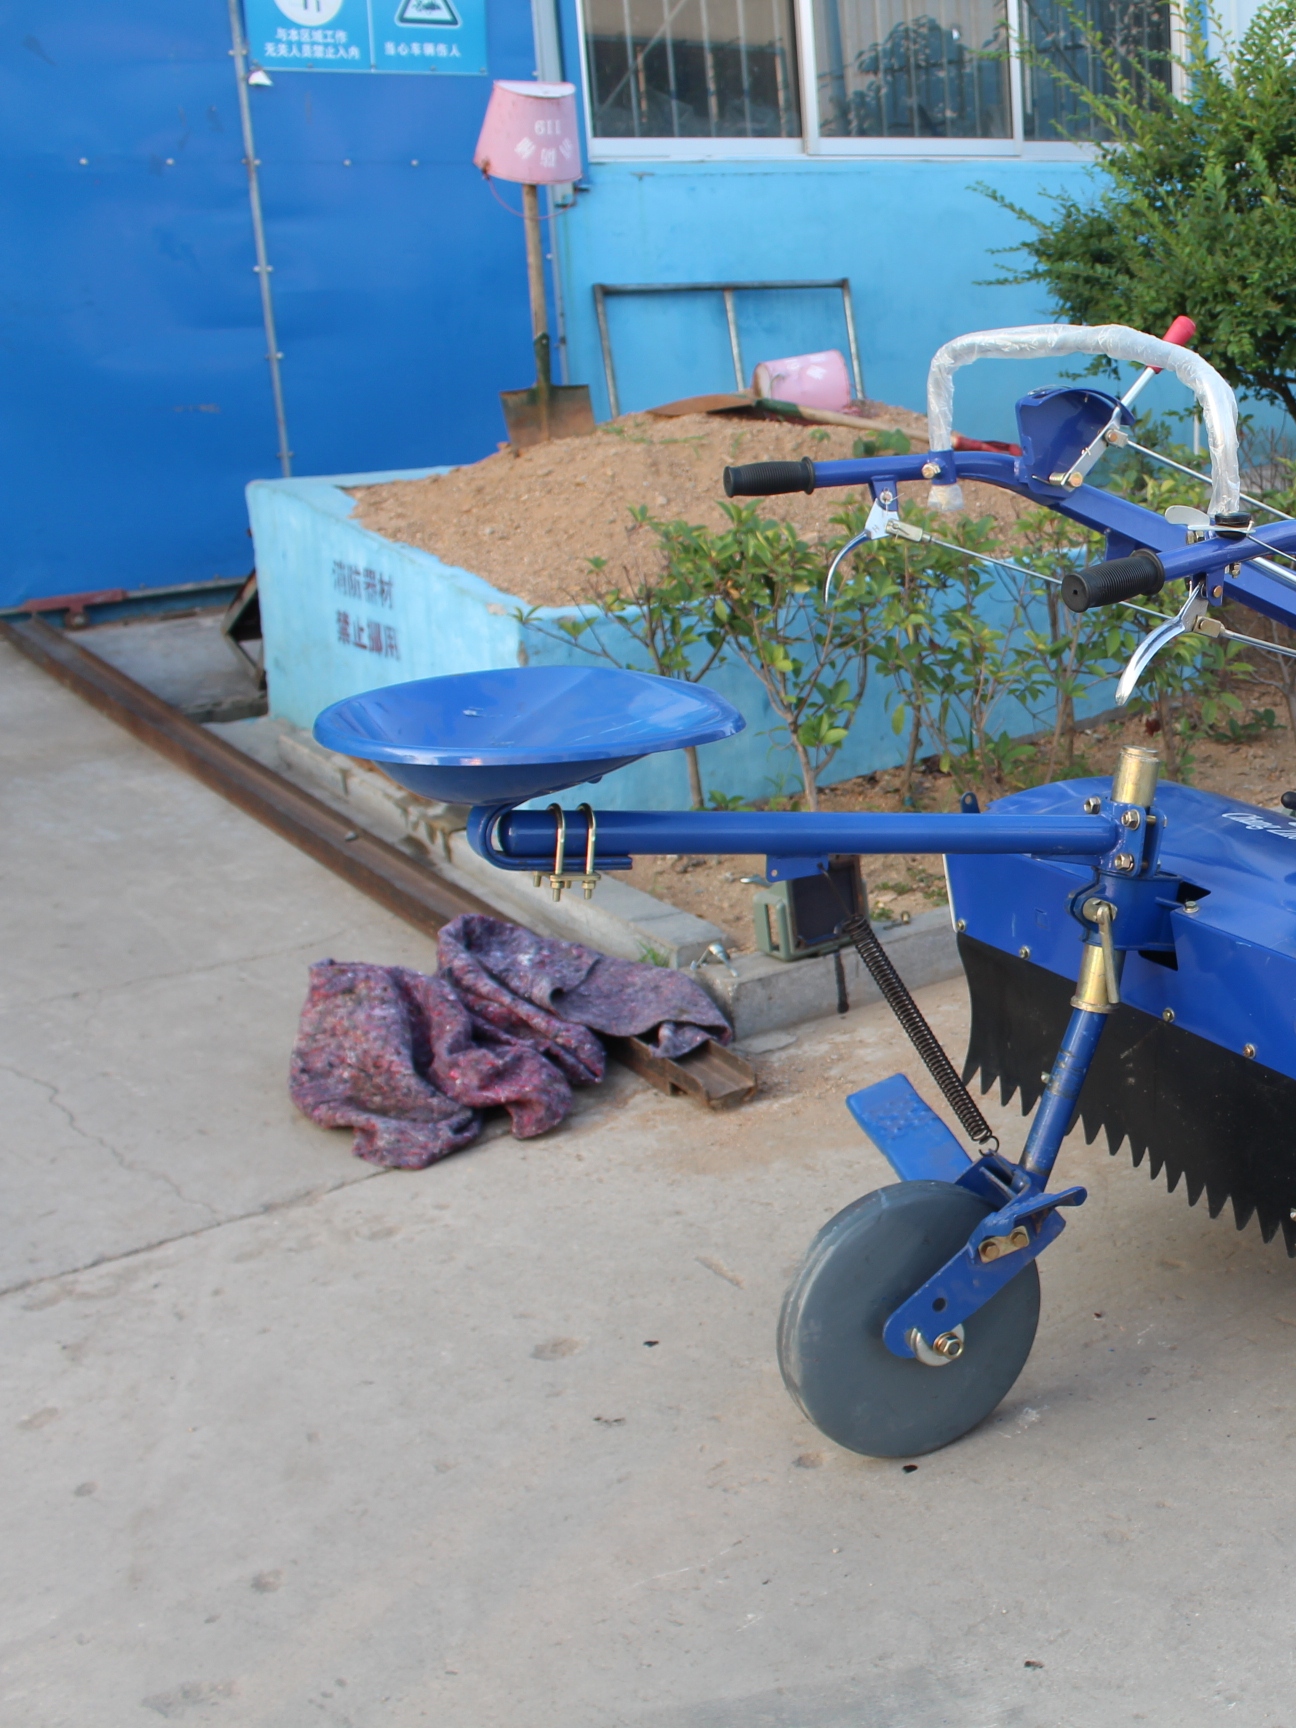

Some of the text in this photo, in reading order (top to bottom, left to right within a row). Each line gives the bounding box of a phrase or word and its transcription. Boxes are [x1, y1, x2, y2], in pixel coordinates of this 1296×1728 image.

[275, 27, 347, 43] 与本区域工作
[264, 42, 360, 59] 无关人员禁止入内
[384, 41, 461, 57] 当心车辆伤人
[534, 119, 562, 135] 119
